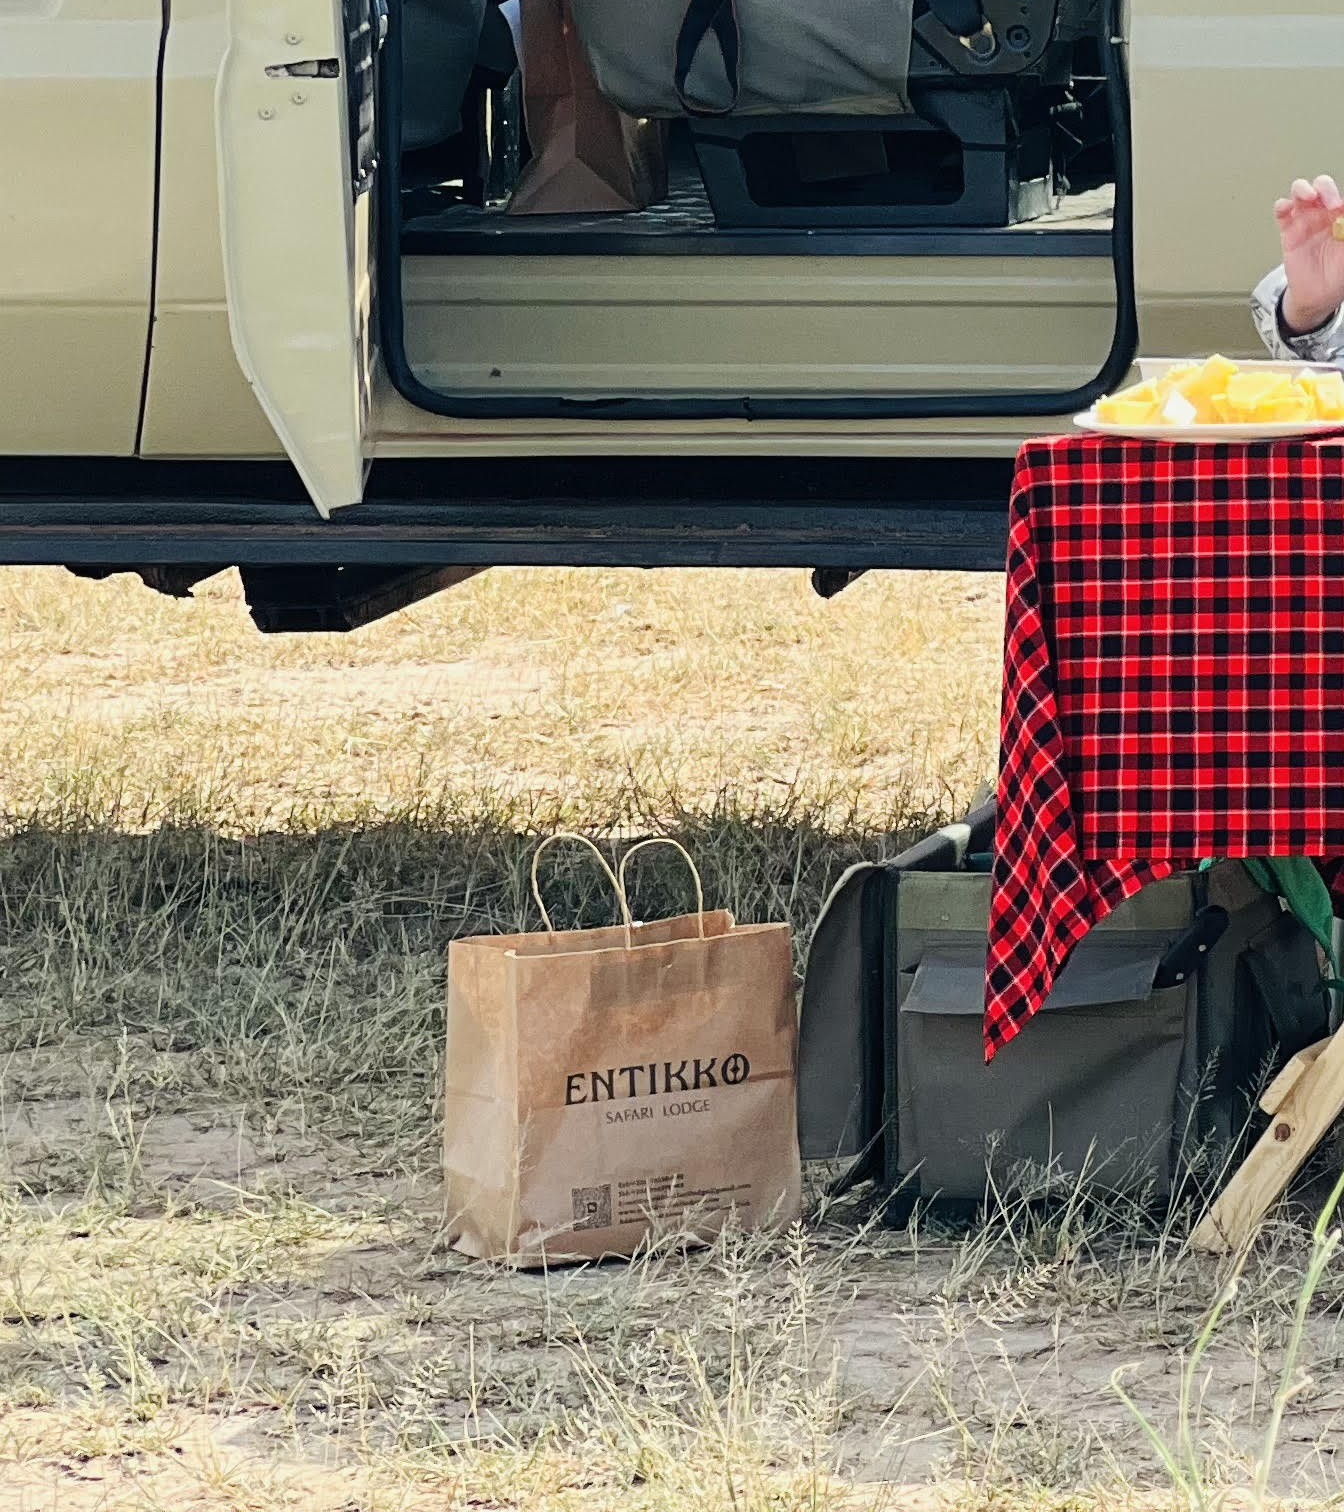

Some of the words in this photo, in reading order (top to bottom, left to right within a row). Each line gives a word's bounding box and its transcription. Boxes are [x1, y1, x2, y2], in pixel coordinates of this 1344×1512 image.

[564, 1053, 751, 1106] ENTIKKO
[606, 1106, 654, 1124] SAFARI
[662, 1099, 712, 1118] LODGE
